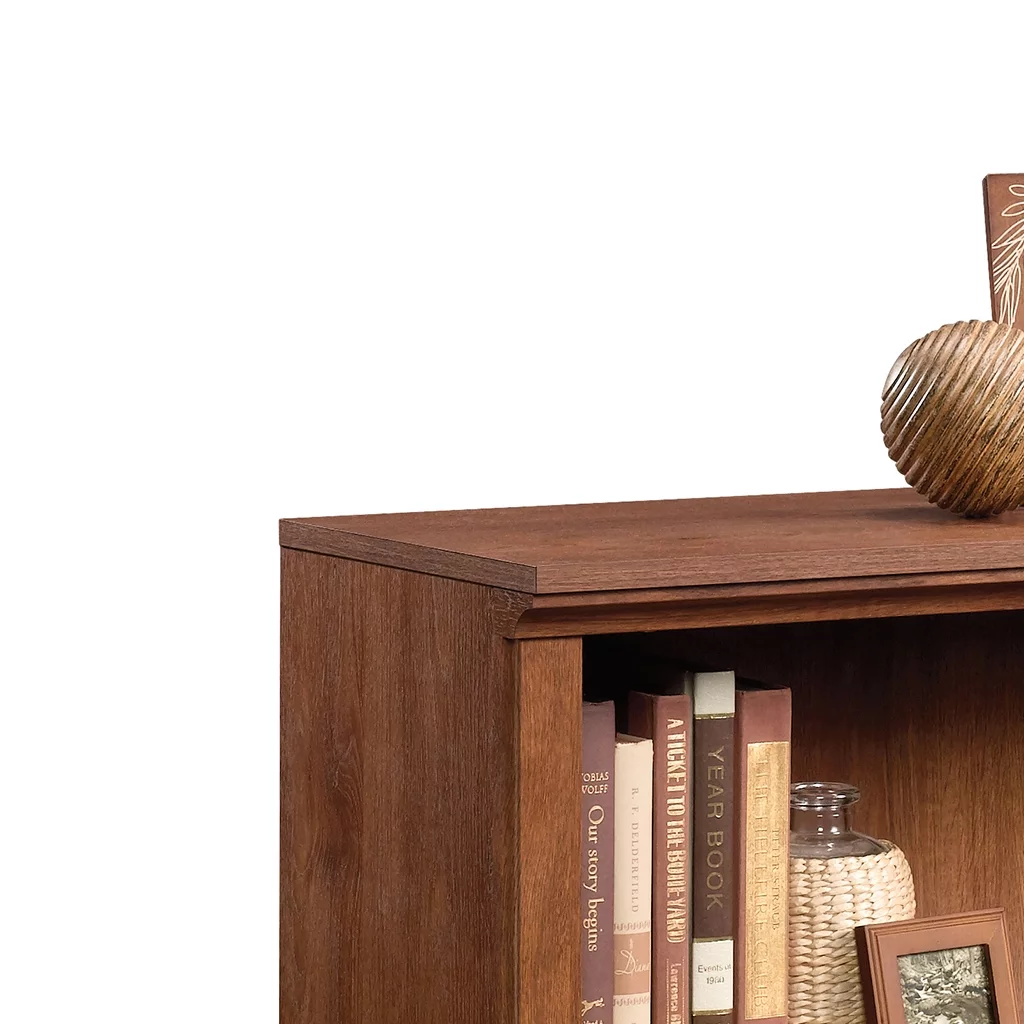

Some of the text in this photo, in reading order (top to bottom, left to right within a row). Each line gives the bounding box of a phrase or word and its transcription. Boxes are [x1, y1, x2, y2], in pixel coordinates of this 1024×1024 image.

[666, 718, 684, 728] A
[581, 771, 609, 782] OBIAS
[666, 731, 687, 793] TICKET
[631, 787, 639, 799] R.
[666, 796, 686, 816] TO
[666, 818, 686, 849] THE
[706, 747, 725, 911] YEAR BOOK
[582, 804, 605, 952] Our story begins
[630, 822, 639, 913] DELDERFIELD
